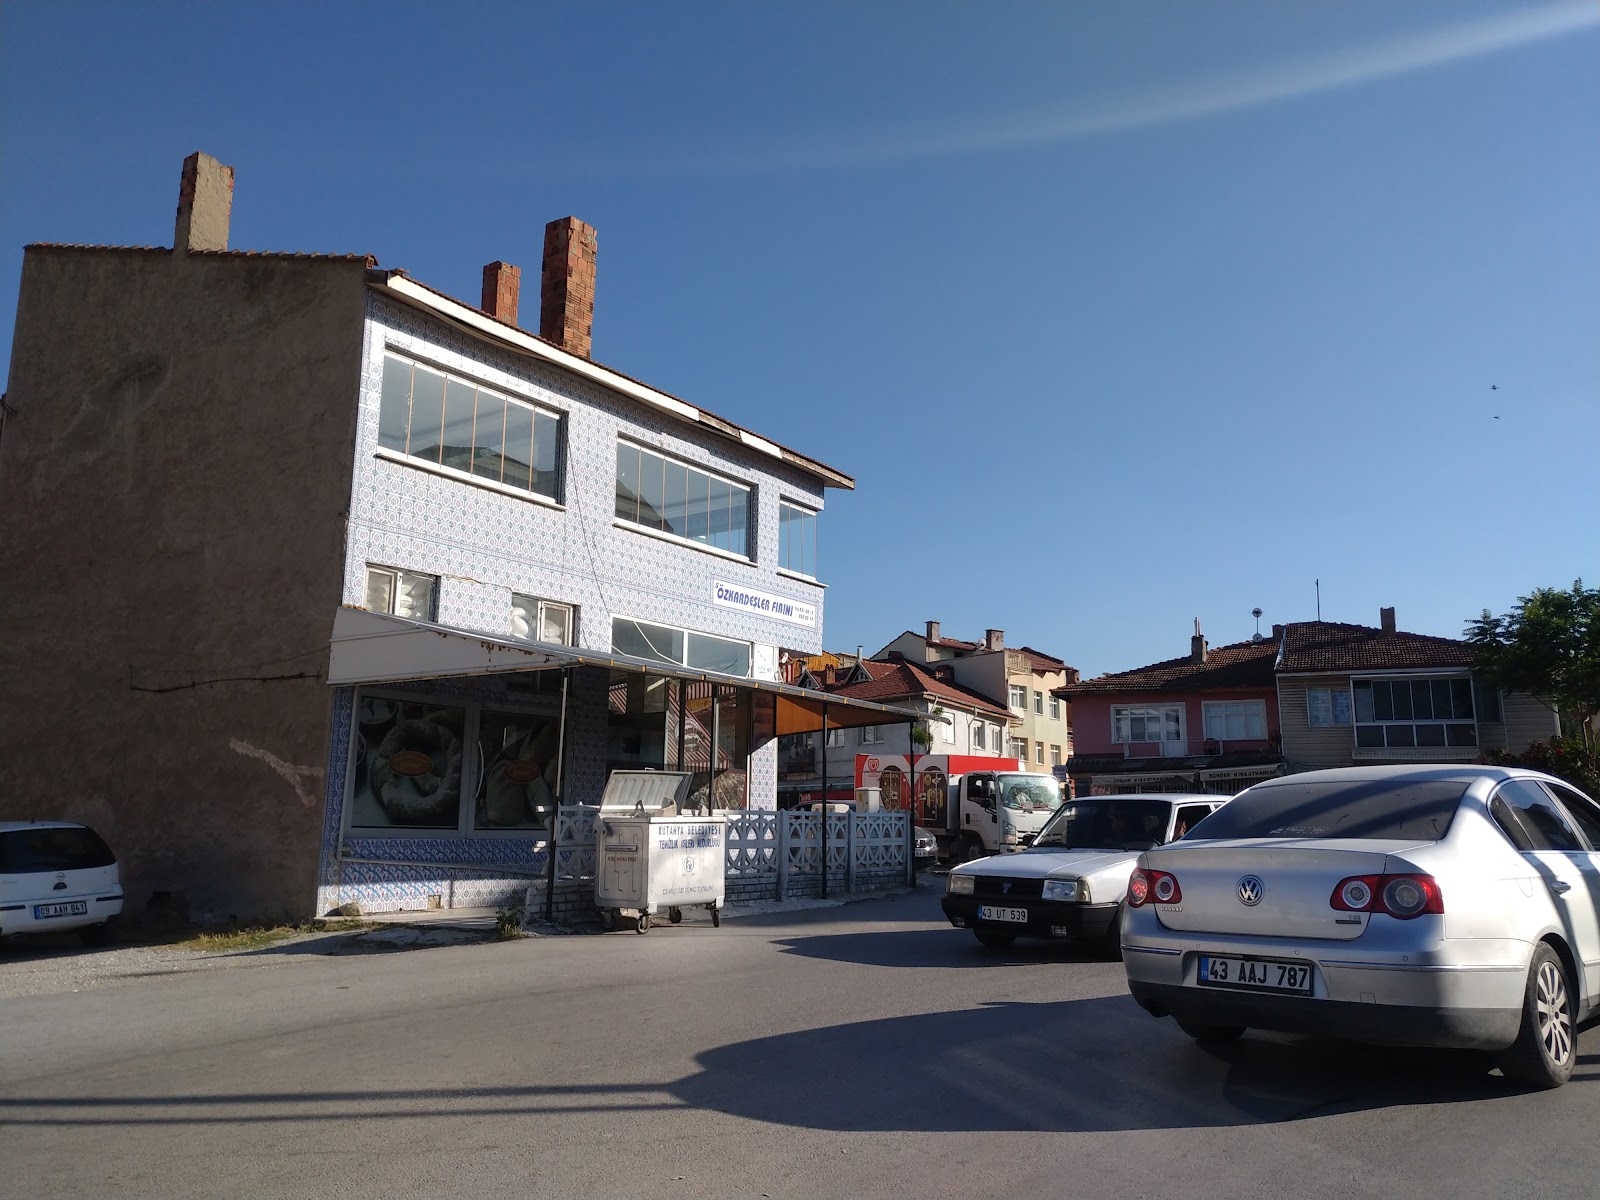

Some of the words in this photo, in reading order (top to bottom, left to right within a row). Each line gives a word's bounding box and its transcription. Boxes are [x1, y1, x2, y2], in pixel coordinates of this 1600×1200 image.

[717, 584, 770, 610] ÖZKARDEŞLER
[772, 601, 794, 617] FIRINI
[40, 906, 50, 916] 09
[982, 908, 992, 918] 43
[996, 909, 1006, 919] UT
[1010, 910, 1026, 921] 539
[1209, 959, 1228, 980] 43
[1238, 962, 1268, 983] AAJ
[1277, 966, 1308, 988] 787
